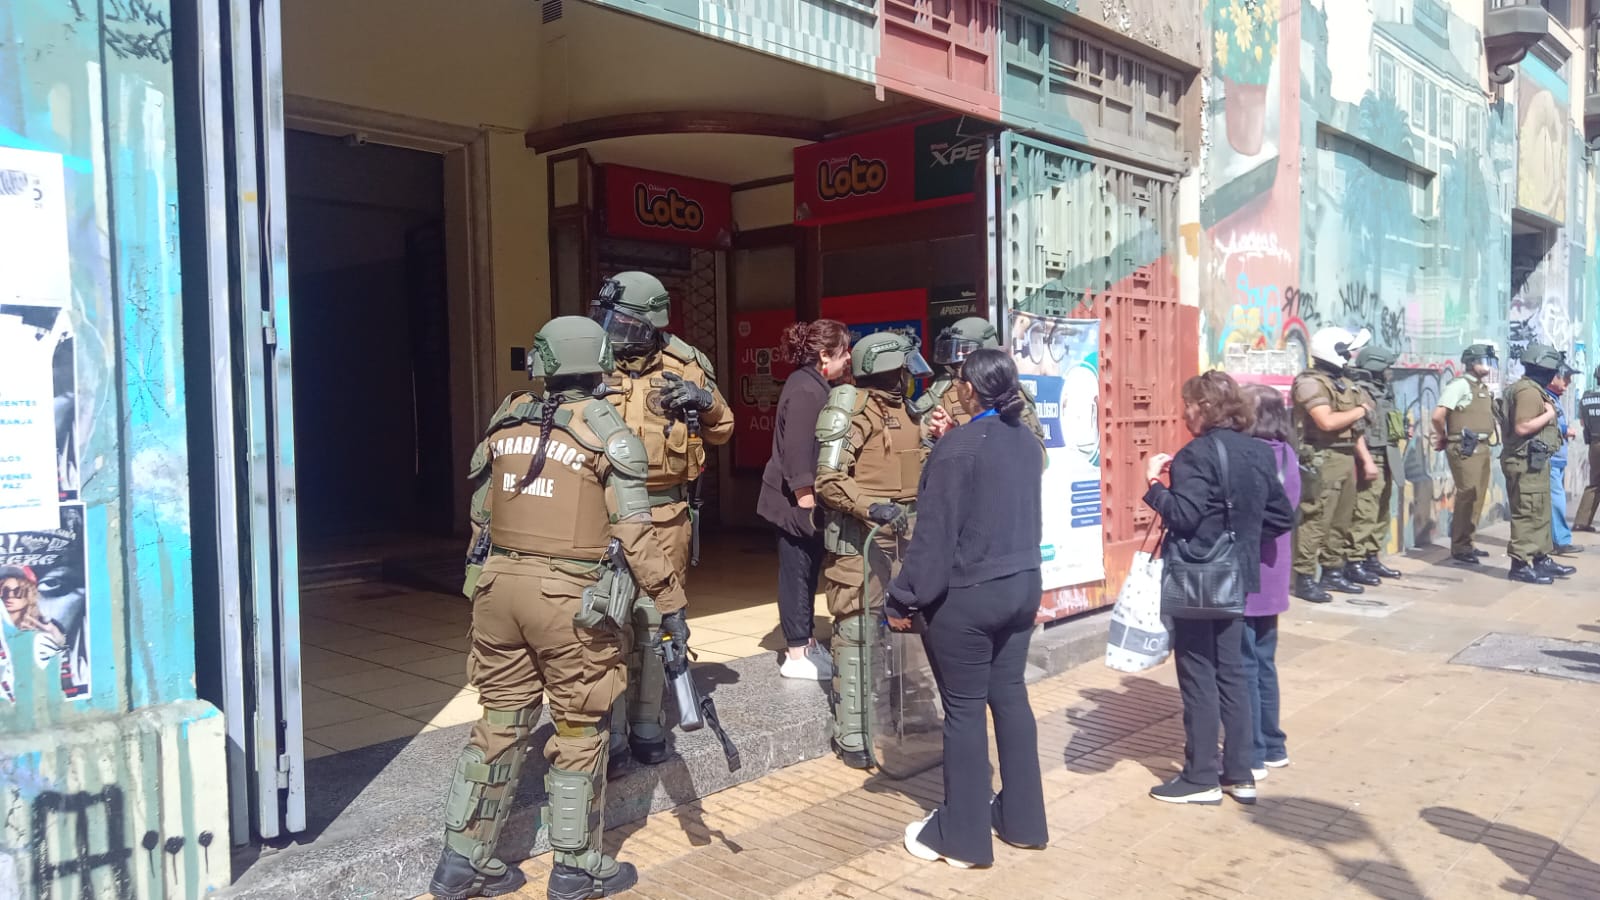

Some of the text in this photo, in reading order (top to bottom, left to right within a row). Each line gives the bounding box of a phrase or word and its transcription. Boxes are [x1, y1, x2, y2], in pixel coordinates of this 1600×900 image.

[817, 153, 887, 201] Loto
[634, 182, 704, 232] Loto
[503, 472, 517, 493] DE
